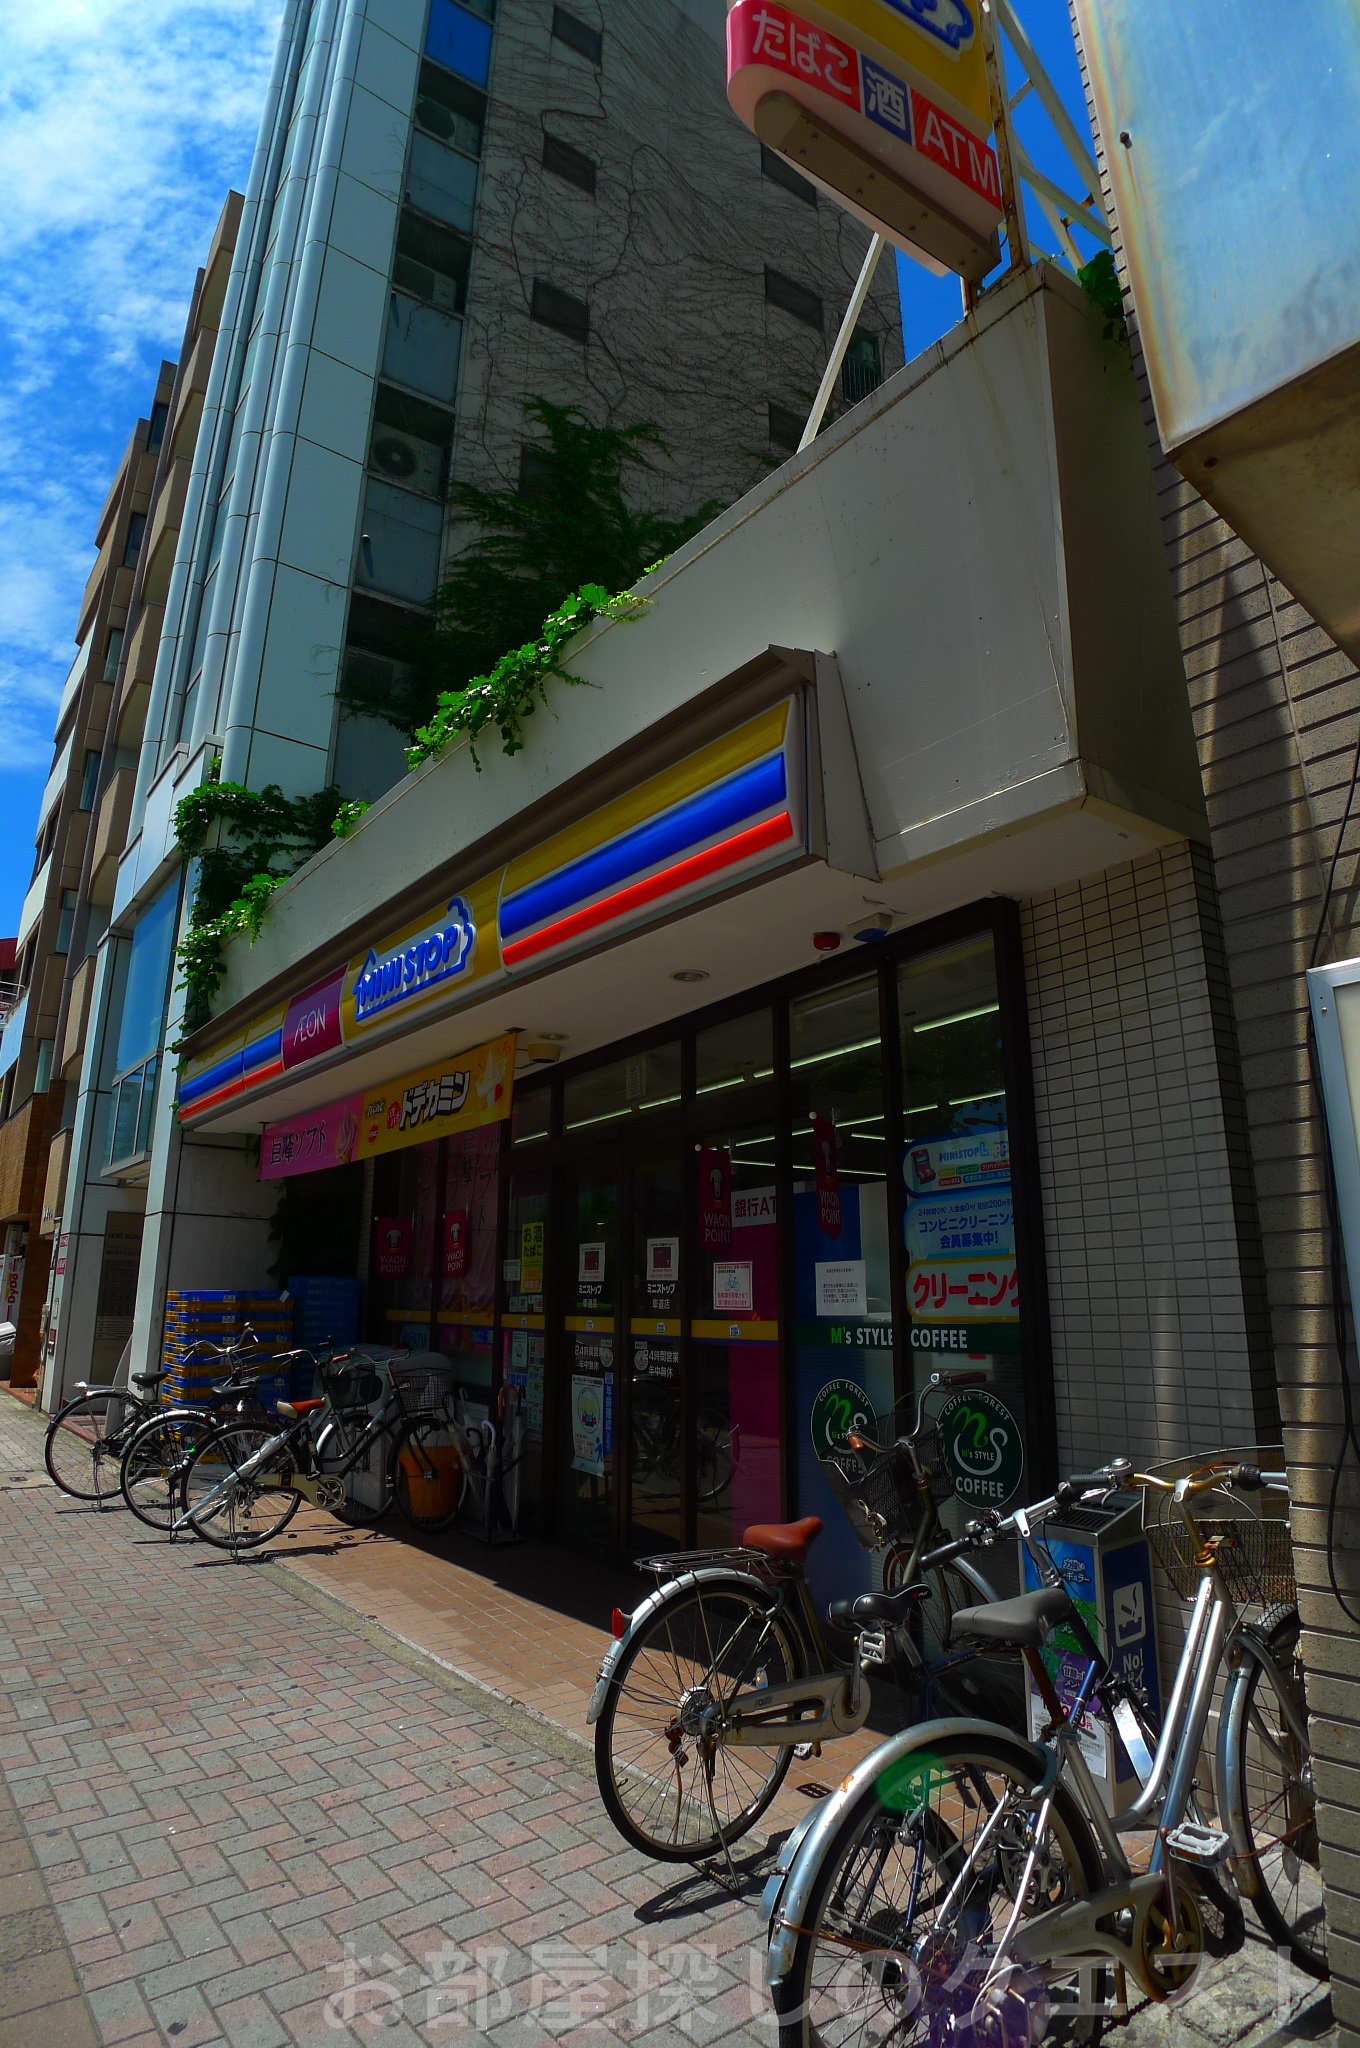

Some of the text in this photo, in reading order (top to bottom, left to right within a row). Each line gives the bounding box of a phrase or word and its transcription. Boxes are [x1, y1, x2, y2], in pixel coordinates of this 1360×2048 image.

[752, 8, 998, 199] たばこ 酒 ATM
[399, 1070, 471, 1132] ドデカミン
[270, 1120, 327, 1166] 巨峰ソフト
[819, 1189, 840, 1207] WAON
[703, 1213, 730, 1227] WAON
[821, 1207, 841, 1224] POINT
[705, 1229, 731, 1243] POINT
[940, 1230, 999, 1249] 会員募集中!
[380, 1255, 406, 1264] WAON
[447, 1249, 464, 1261] WAON
[380, 1264, 405, 1273] POINT
[447, 1259, 464, 1271] POINT
[7, 1273, 19, 1304] DyDo
[578, 1284, 602, 1295] ミニストップ
[647, 1283, 676, 1295] ミニストップ
[830, 1327, 968, 1349] M's STYLE COFFEE
[818, 1381, 870, 1407] COFFEE FOREST
[974, 1450, 995, 1462] STYLE
[955, 1476, 1005, 1499] COFFEE
